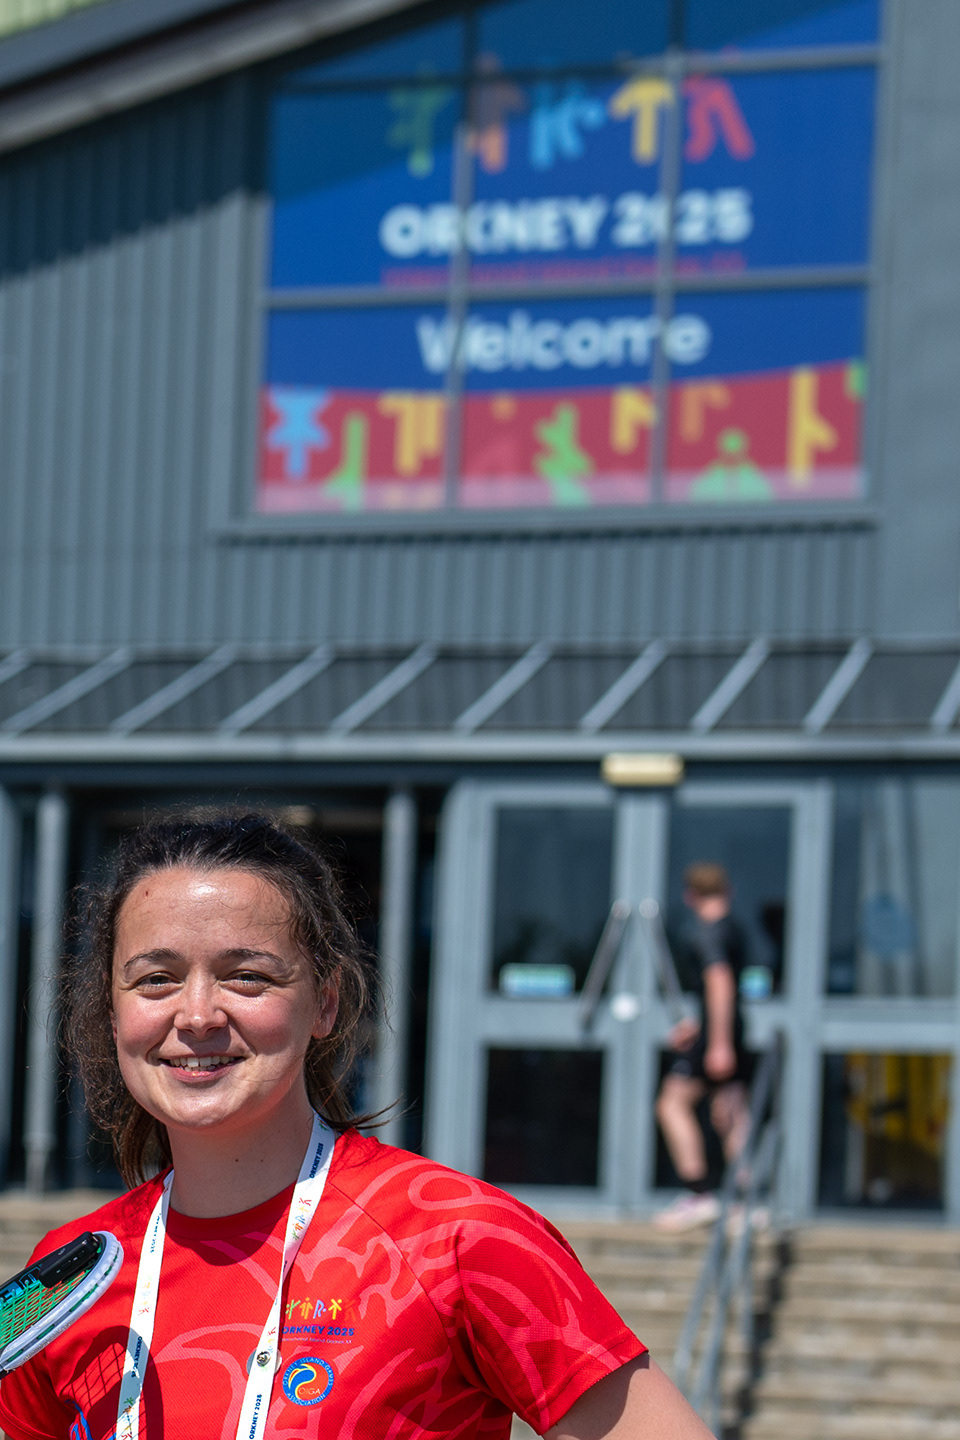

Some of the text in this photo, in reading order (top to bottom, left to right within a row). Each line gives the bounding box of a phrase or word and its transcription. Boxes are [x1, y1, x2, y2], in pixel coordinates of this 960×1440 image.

[309, 1154, 321, 1179] ORKNEY
[281, 1325, 355, 1336] ORKNEY 2025
[248, 1393, 262, 1440] ORKNEY 2025
